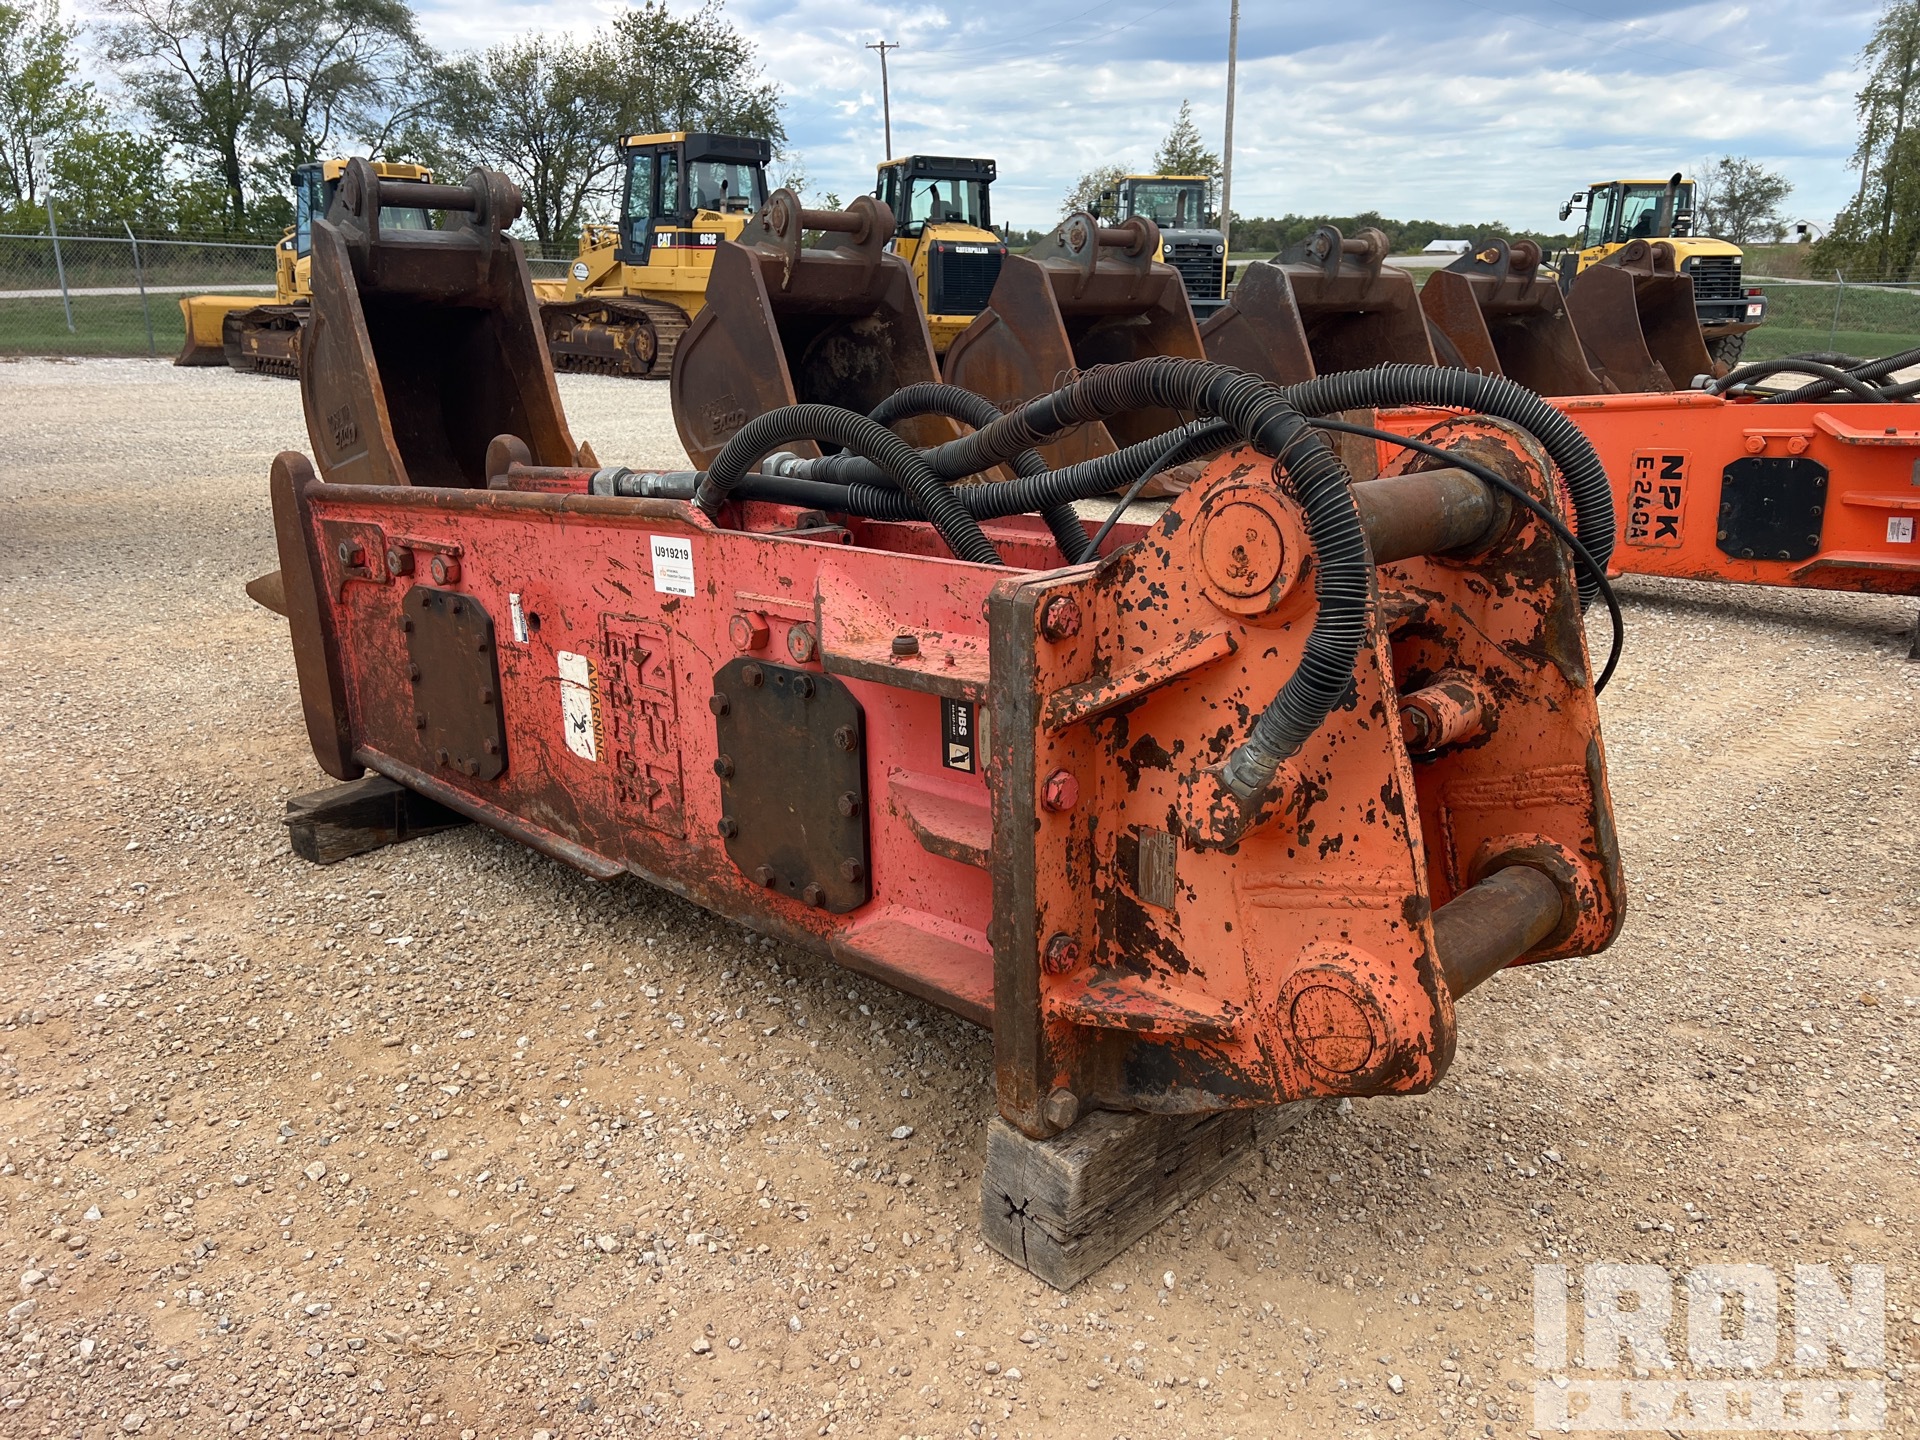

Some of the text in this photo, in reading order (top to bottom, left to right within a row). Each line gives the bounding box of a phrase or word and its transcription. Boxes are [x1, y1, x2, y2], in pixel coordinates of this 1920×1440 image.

[657, 233, 672, 248] CAT
[700, 233, 717, 245] 963C
[955, 246, 989, 254] CATERPILLAR
[1630, 457, 1655, 538] E-240A
[1655, 456, 1684, 540] NPK
[655, 546, 689, 560] U919219
[589, 677, 605, 763] WARNING
[634, 633, 677, 814] NPK
[958, 706, 968, 736] HBS
